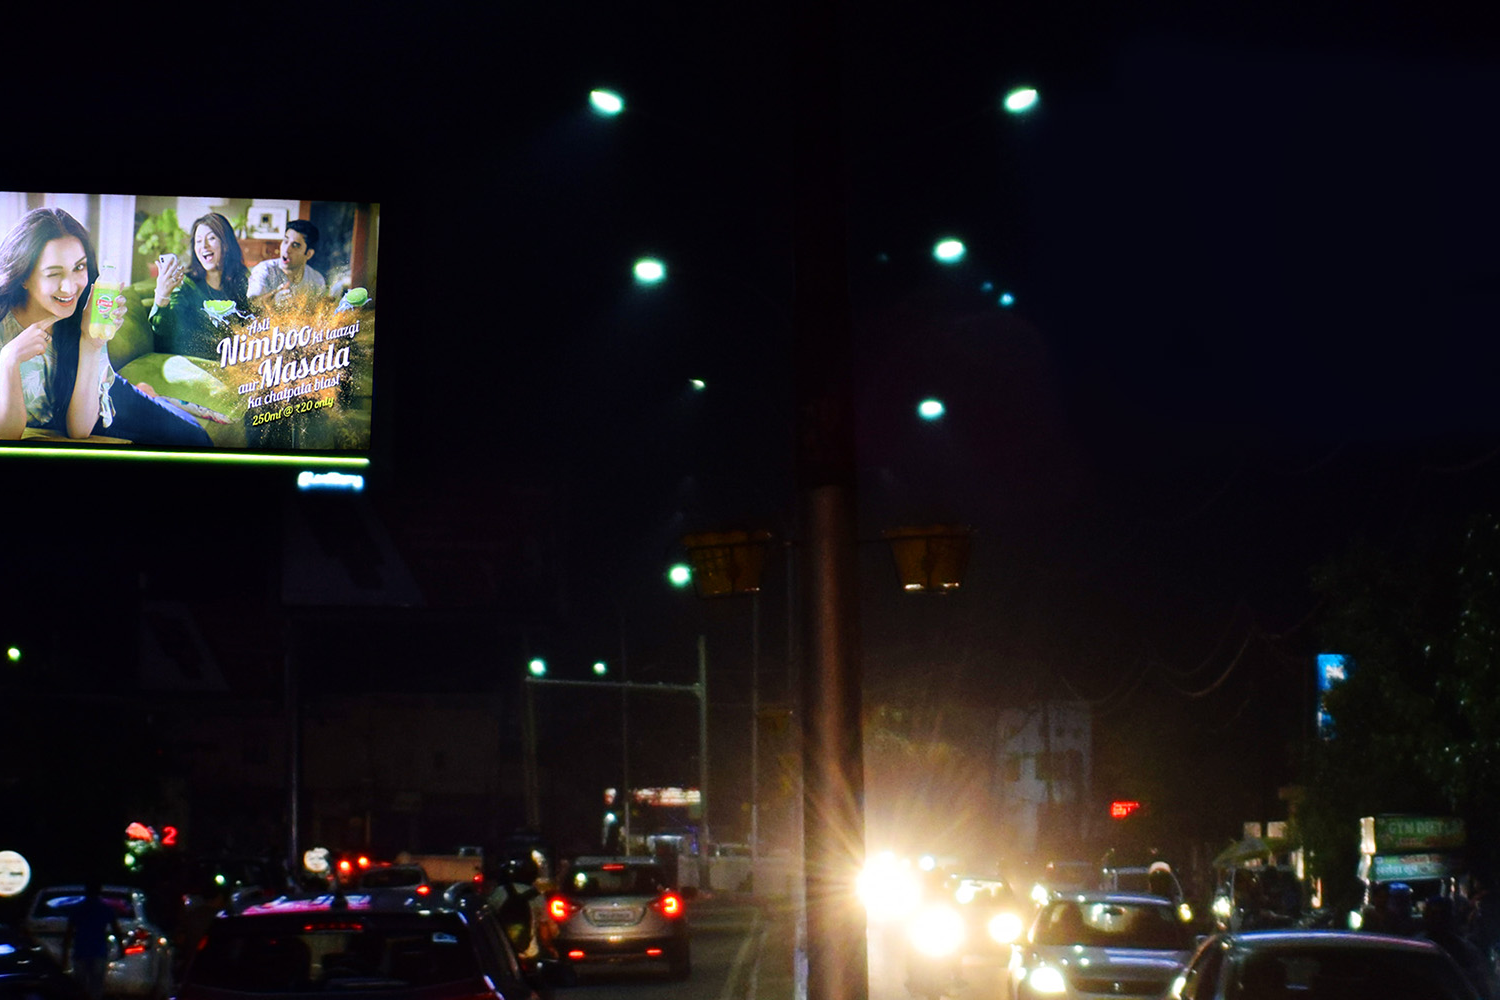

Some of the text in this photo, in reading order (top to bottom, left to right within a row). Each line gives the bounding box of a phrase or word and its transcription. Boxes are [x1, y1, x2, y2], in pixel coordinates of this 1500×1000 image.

[247, 318, 270, 336] Asli
[216, 320, 360, 368] Nimboo ki taazgi
[238, 344, 350, 395] aur Masala
[248, 374, 341, 409] ka chatpata blast
[252, 409, 283, 426] 250ml
[314, 396, 334, 409] only
[162, 826, 177, 845] 2
